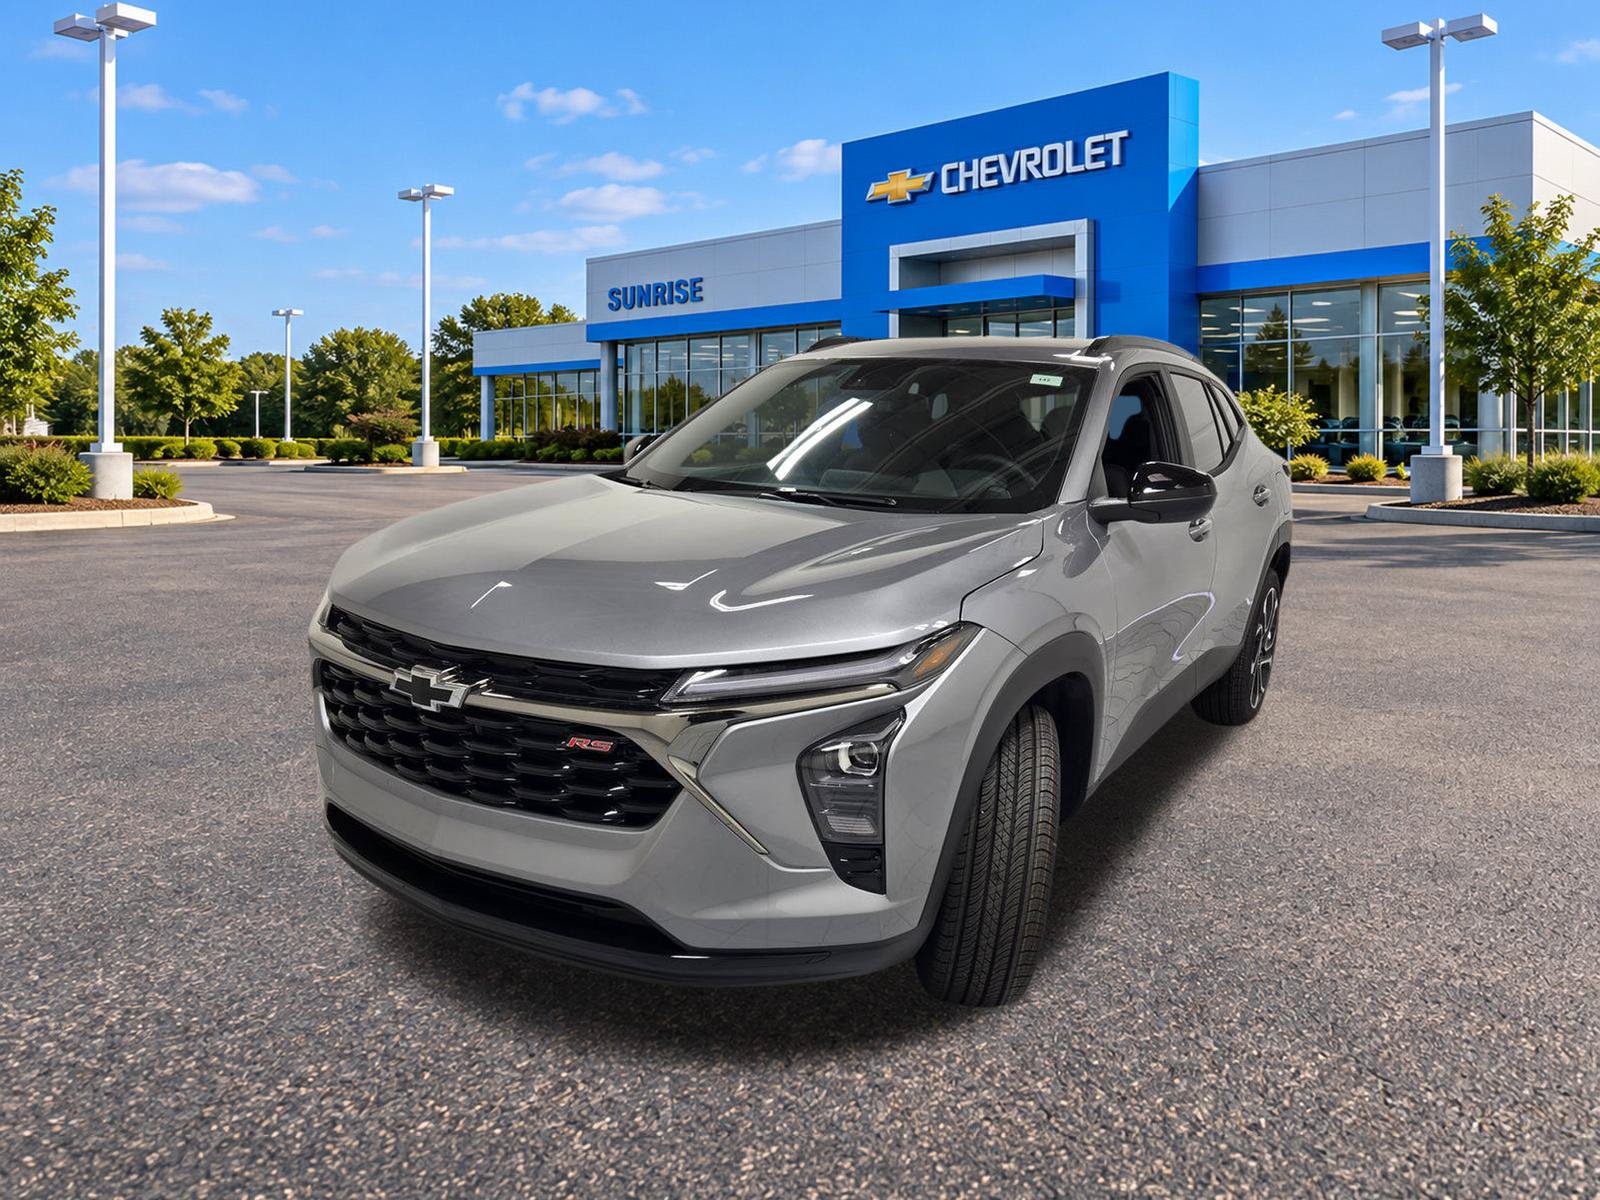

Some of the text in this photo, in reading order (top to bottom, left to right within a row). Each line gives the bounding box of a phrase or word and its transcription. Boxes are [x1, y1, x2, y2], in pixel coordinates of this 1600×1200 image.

[941, 130, 1129, 194] CHEVROLET
[608, 277, 704, 312] SUNRISE
[567, 737, 613, 751] RS
